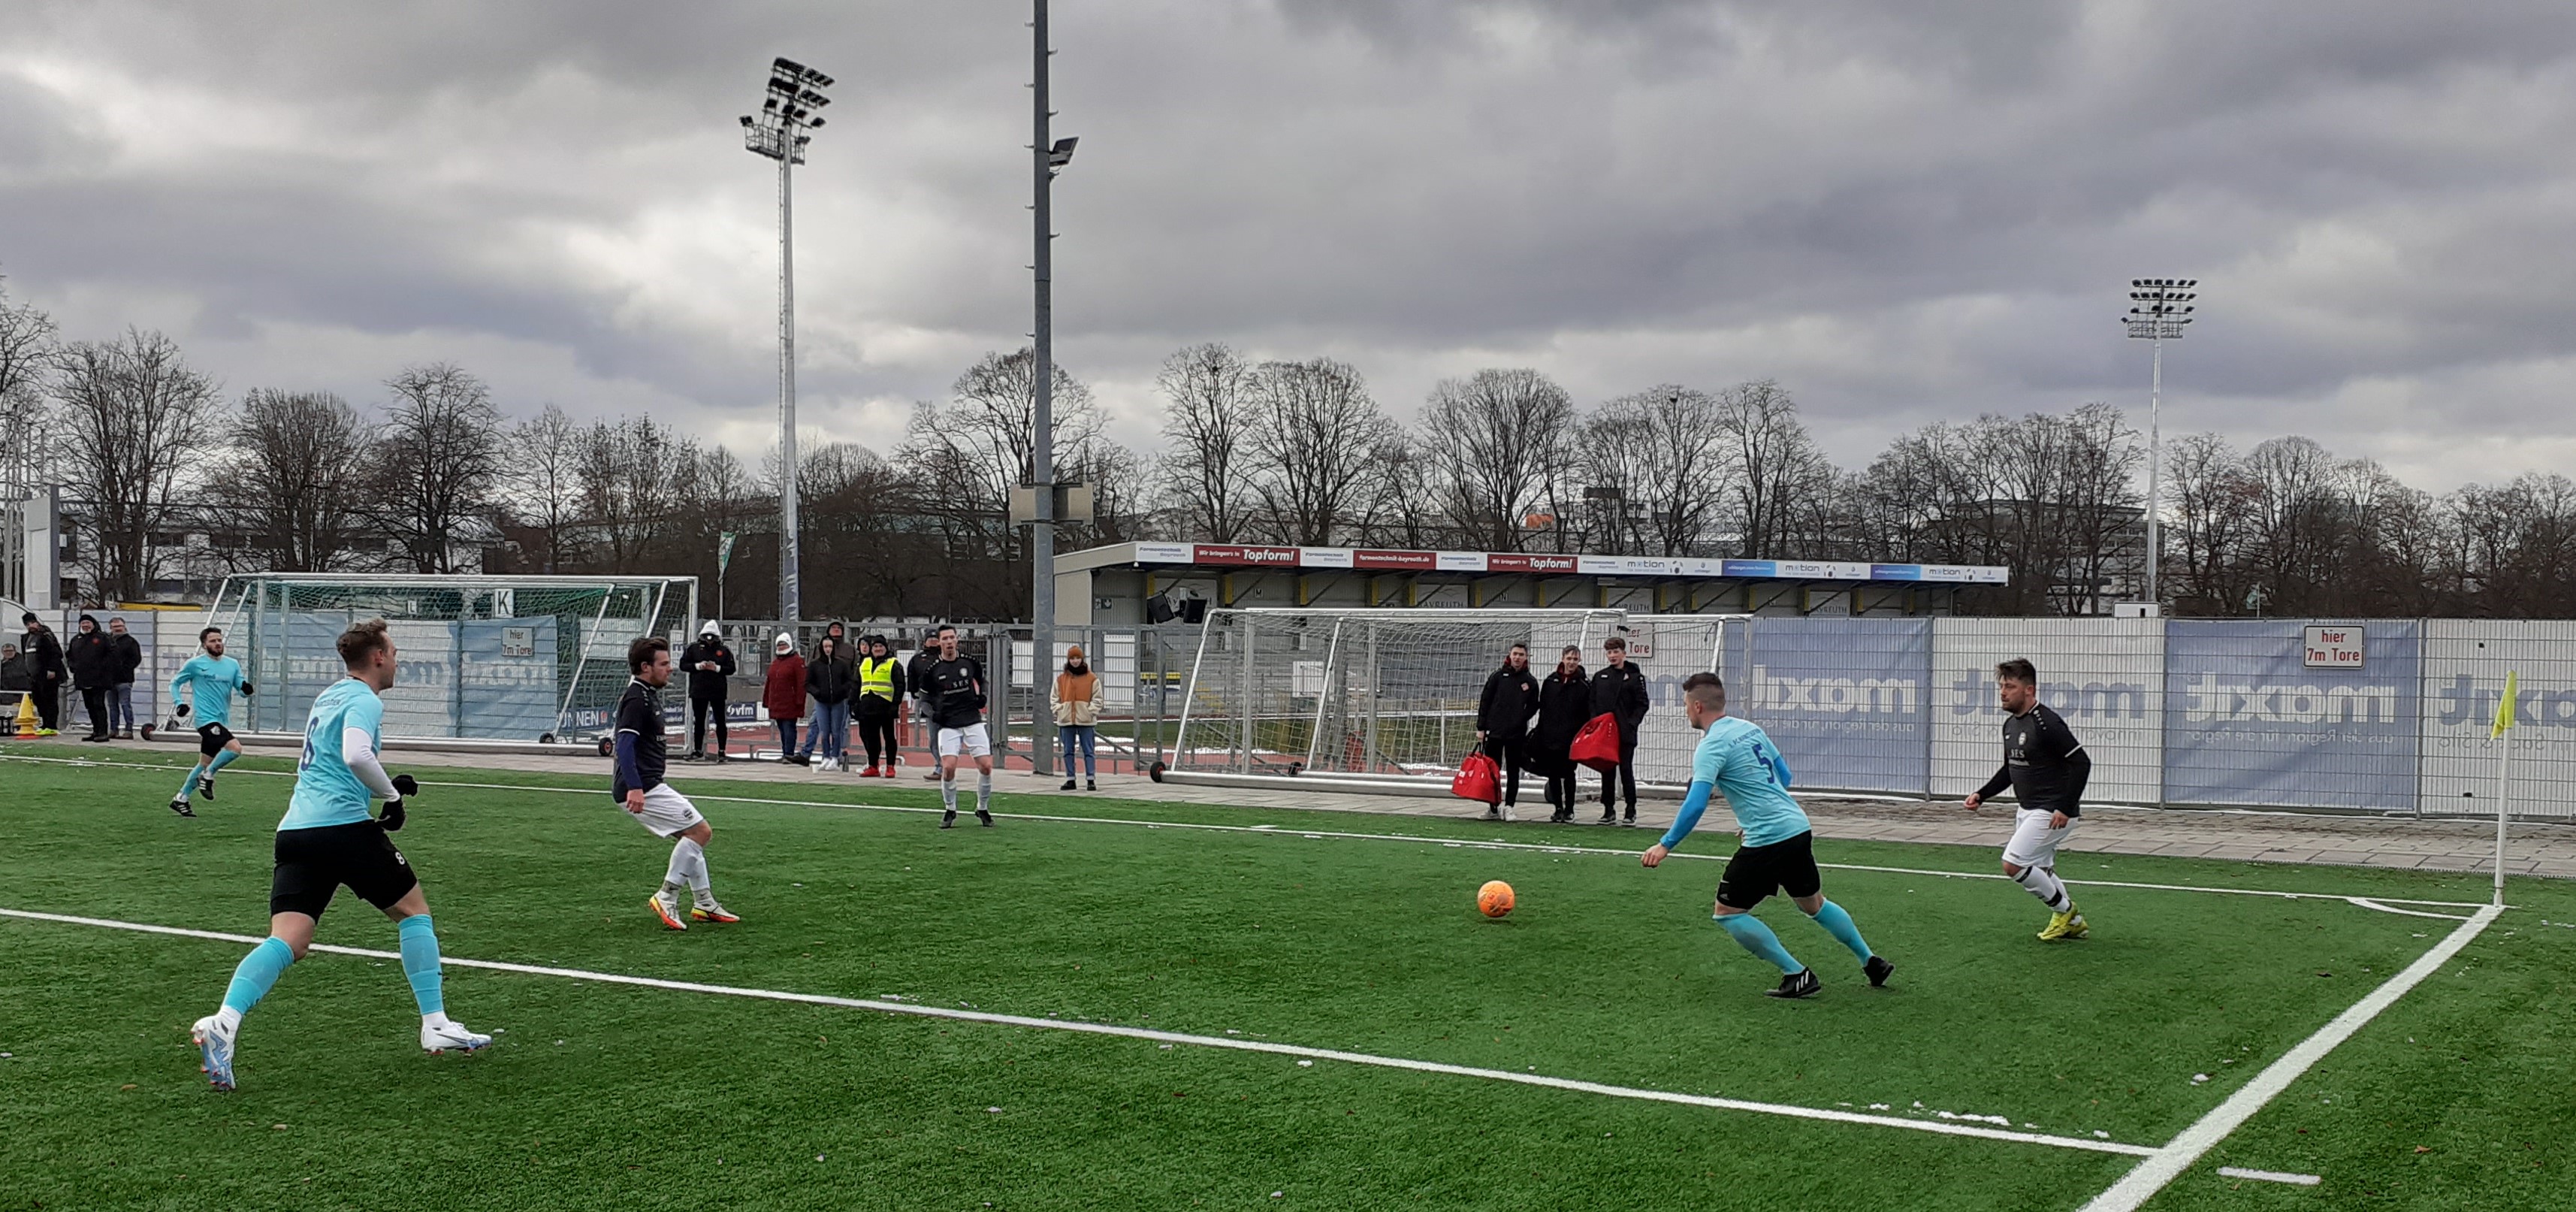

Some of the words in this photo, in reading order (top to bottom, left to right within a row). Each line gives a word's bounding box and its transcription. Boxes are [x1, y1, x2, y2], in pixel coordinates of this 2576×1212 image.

[1243, 549, 1294, 562] Topform!
[1530, 557, 1572, 570] Topform!
[497, 591, 509, 615] K
[509, 629, 524, 639] hier
[2321, 629, 2346, 643] hier
[516, 644, 532, 654] Tore
[1629, 641, 1650, 654] Tore
[2306, 648, 2326, 662] 7m
[2332, 648, 2360, 662] Tore
[736, 704, 753, 716] vfm
[1751, 743, 1775, 784] 5
